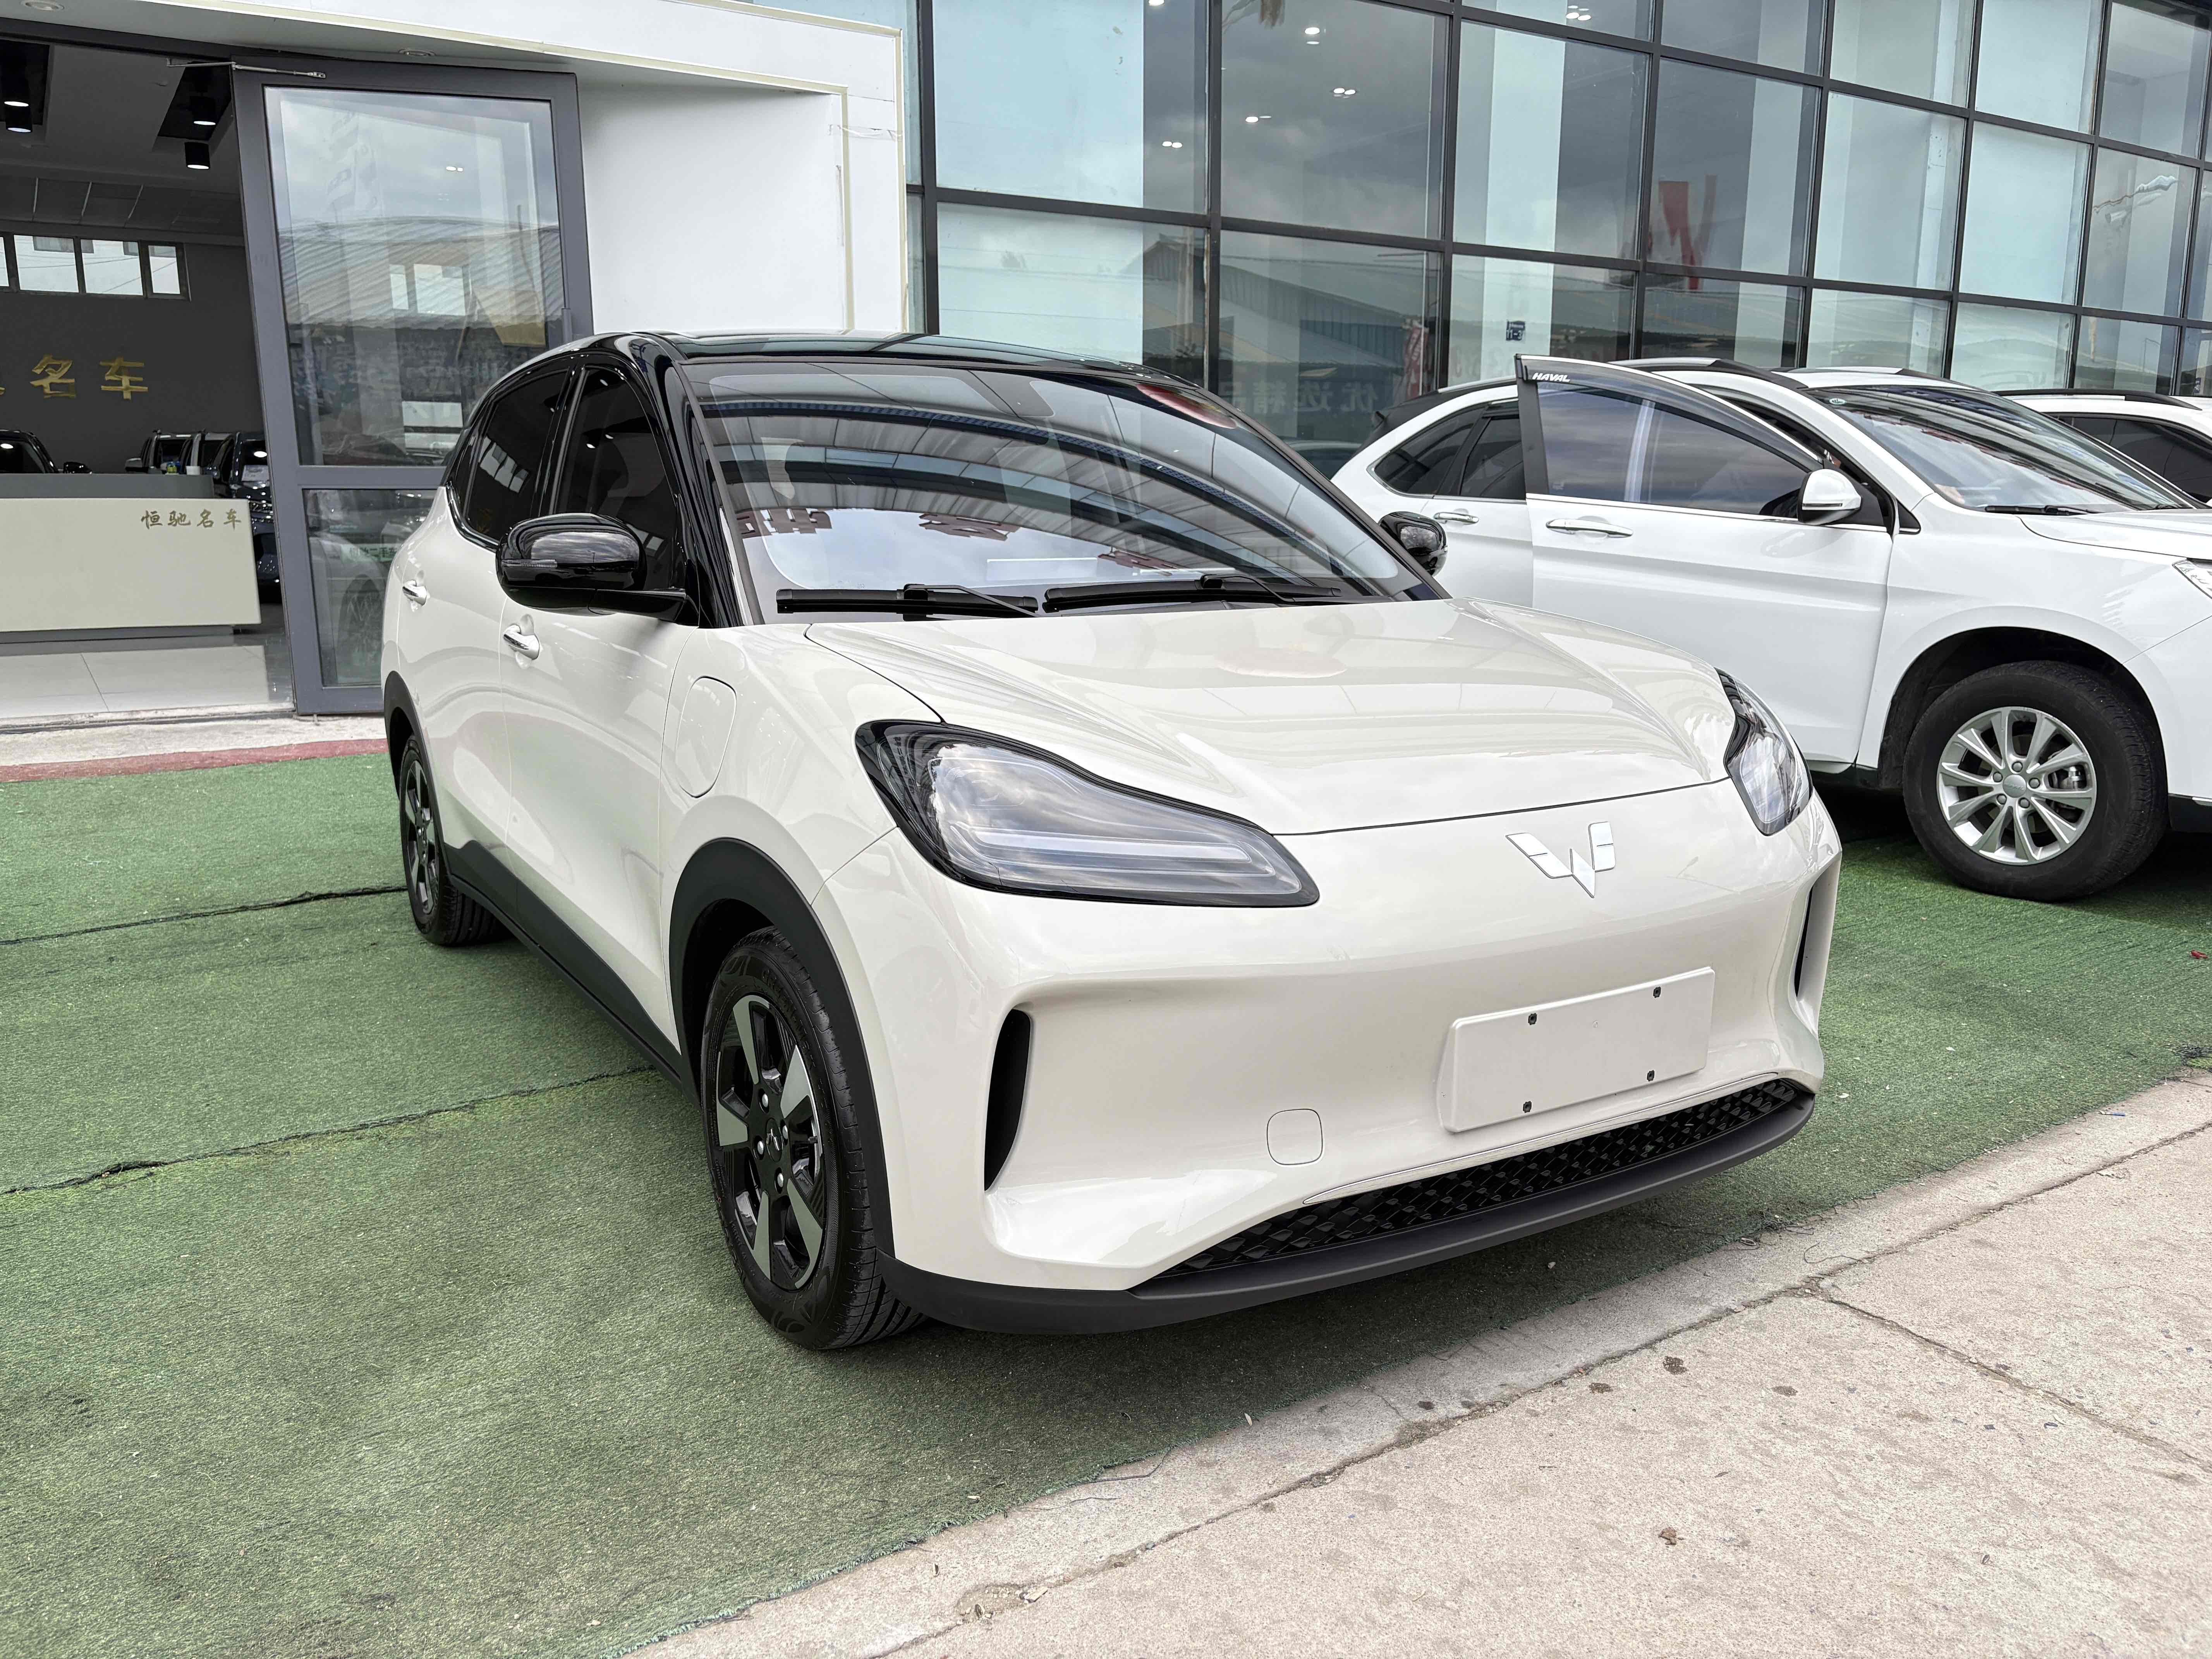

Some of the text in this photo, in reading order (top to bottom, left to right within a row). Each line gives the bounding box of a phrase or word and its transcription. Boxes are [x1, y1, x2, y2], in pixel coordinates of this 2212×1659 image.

[0, 353, 148, 400] 名车
[1532, 373, 1570, 382] HAVAL
[141, 508, 242, 530] 恒驰名车
